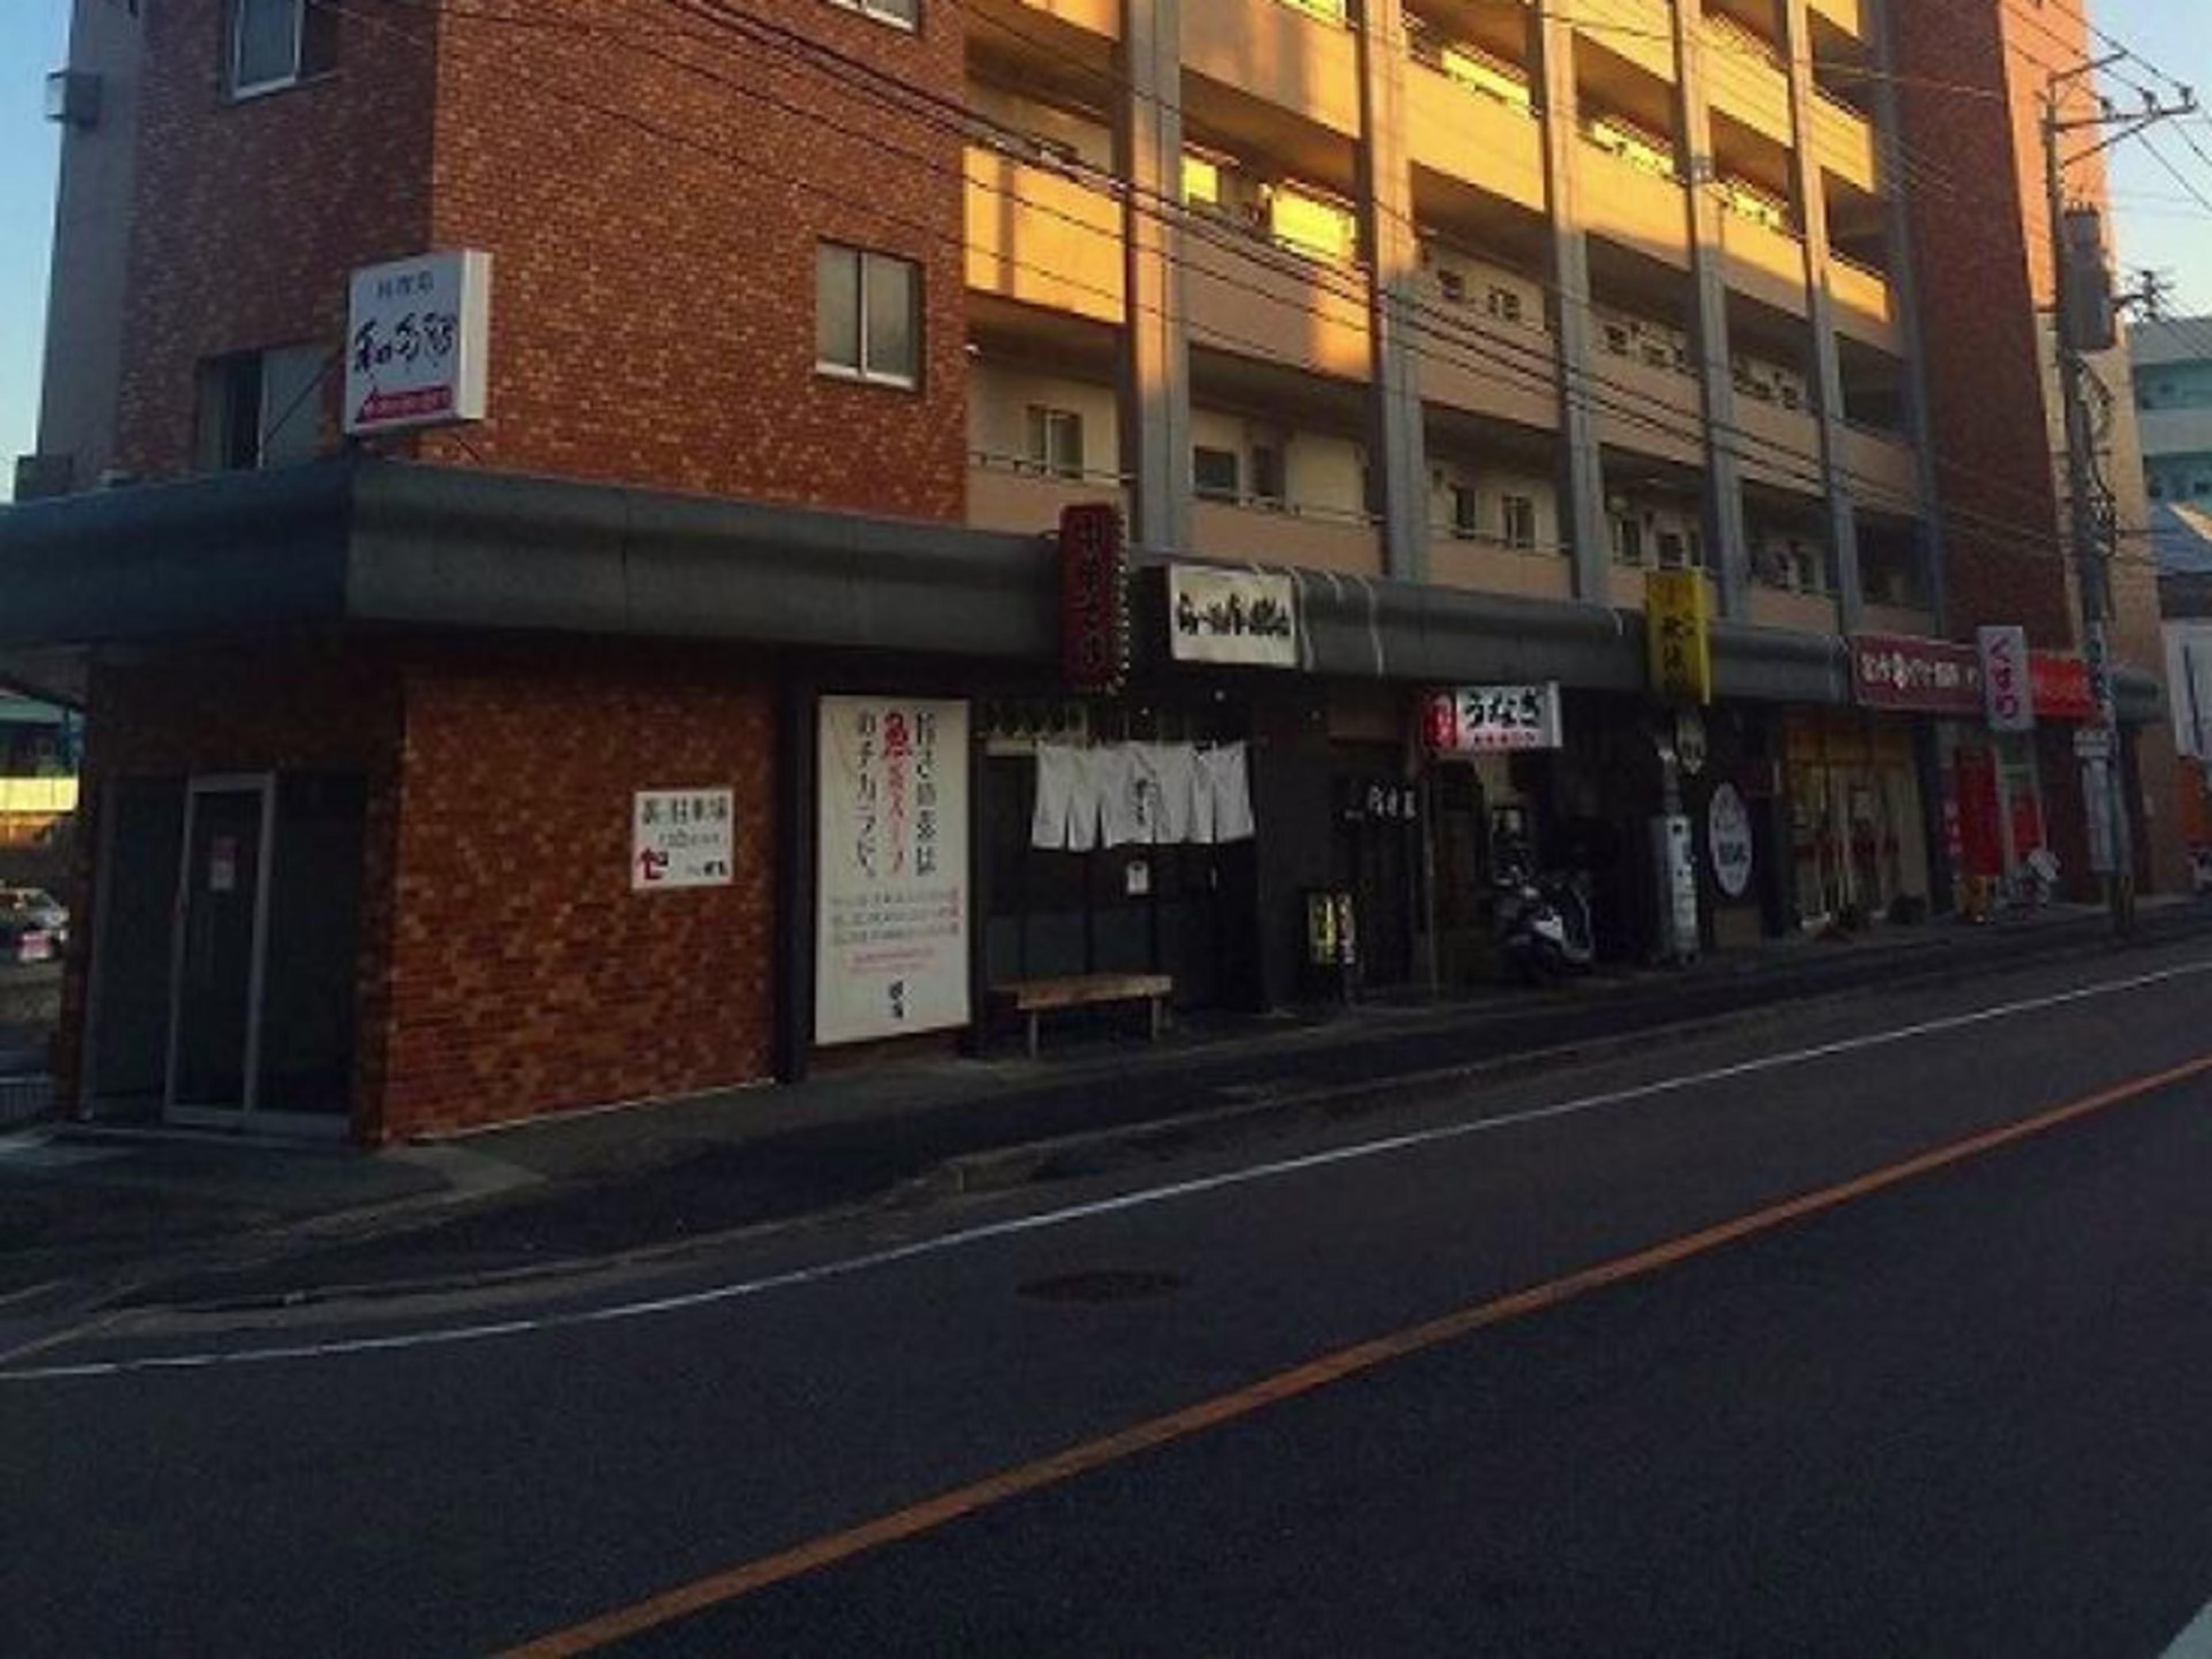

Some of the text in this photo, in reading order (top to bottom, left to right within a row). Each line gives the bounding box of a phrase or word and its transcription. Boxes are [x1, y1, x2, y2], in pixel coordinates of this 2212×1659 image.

[1990, 636, 2018, 719] くすり
[1466, 690, 1540, 730] うなぎ
